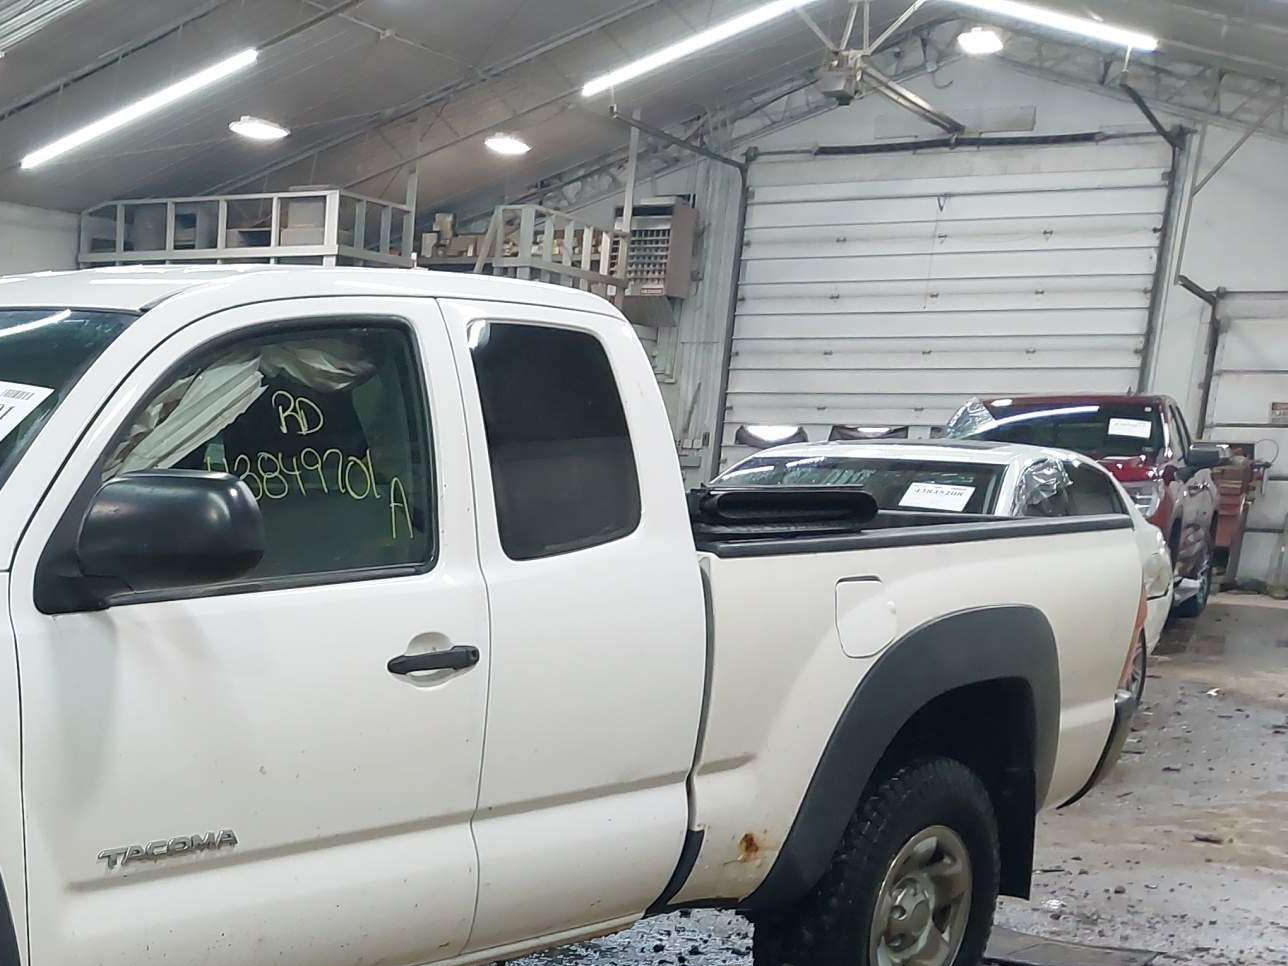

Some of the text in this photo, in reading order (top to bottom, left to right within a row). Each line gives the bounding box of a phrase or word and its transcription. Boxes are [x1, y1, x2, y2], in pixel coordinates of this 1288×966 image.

[272, 390, 325, 435] RD
[389, 476, 414, 539] A
[97, 829, 239, 869] TACOMA
